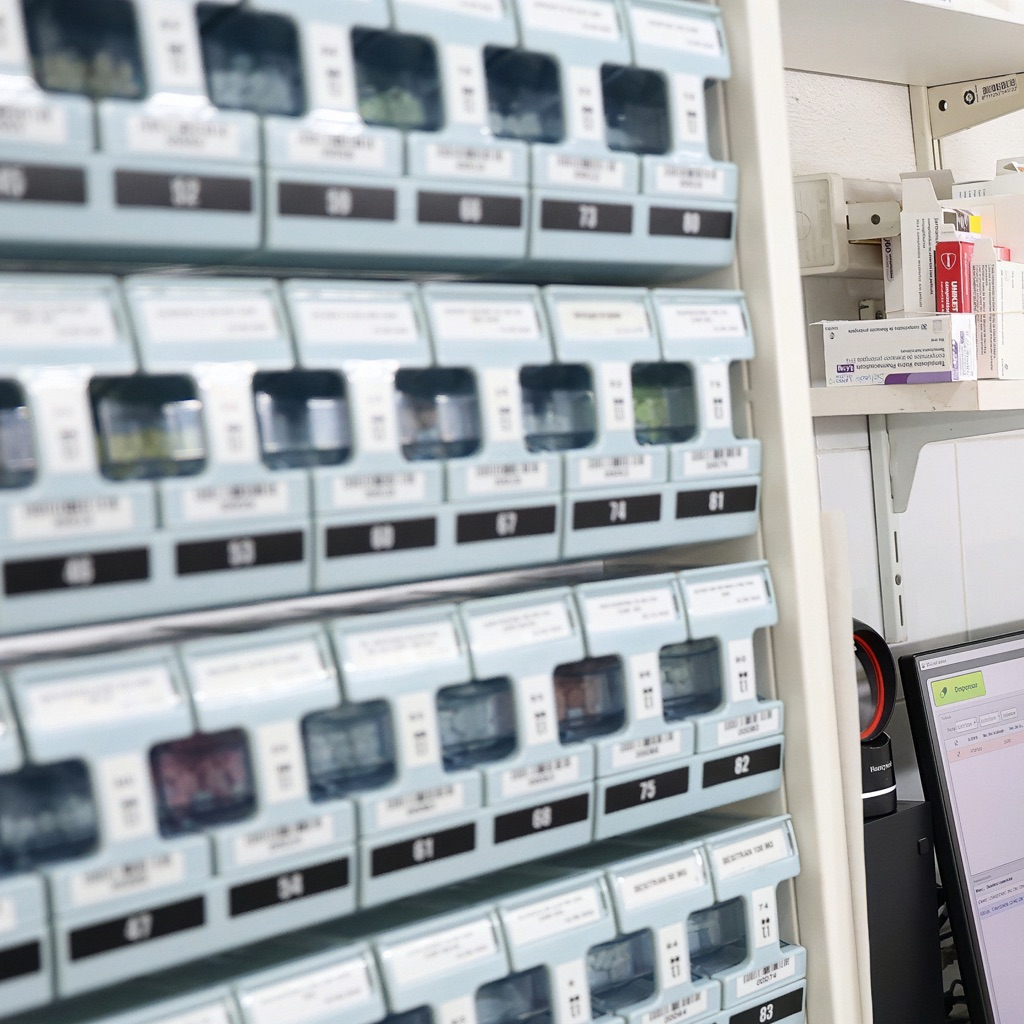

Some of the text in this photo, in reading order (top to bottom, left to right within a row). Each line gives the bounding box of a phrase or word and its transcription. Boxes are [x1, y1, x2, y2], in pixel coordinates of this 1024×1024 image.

[579, 204, 597, 228] 73
[709, 492, 724, 511] 81
[735, 755, 750, 774] 82
[640, 780, 656, 800] 75
[413, 838, 434, 861] 61
[760, 1004, 773, 1022] 83
